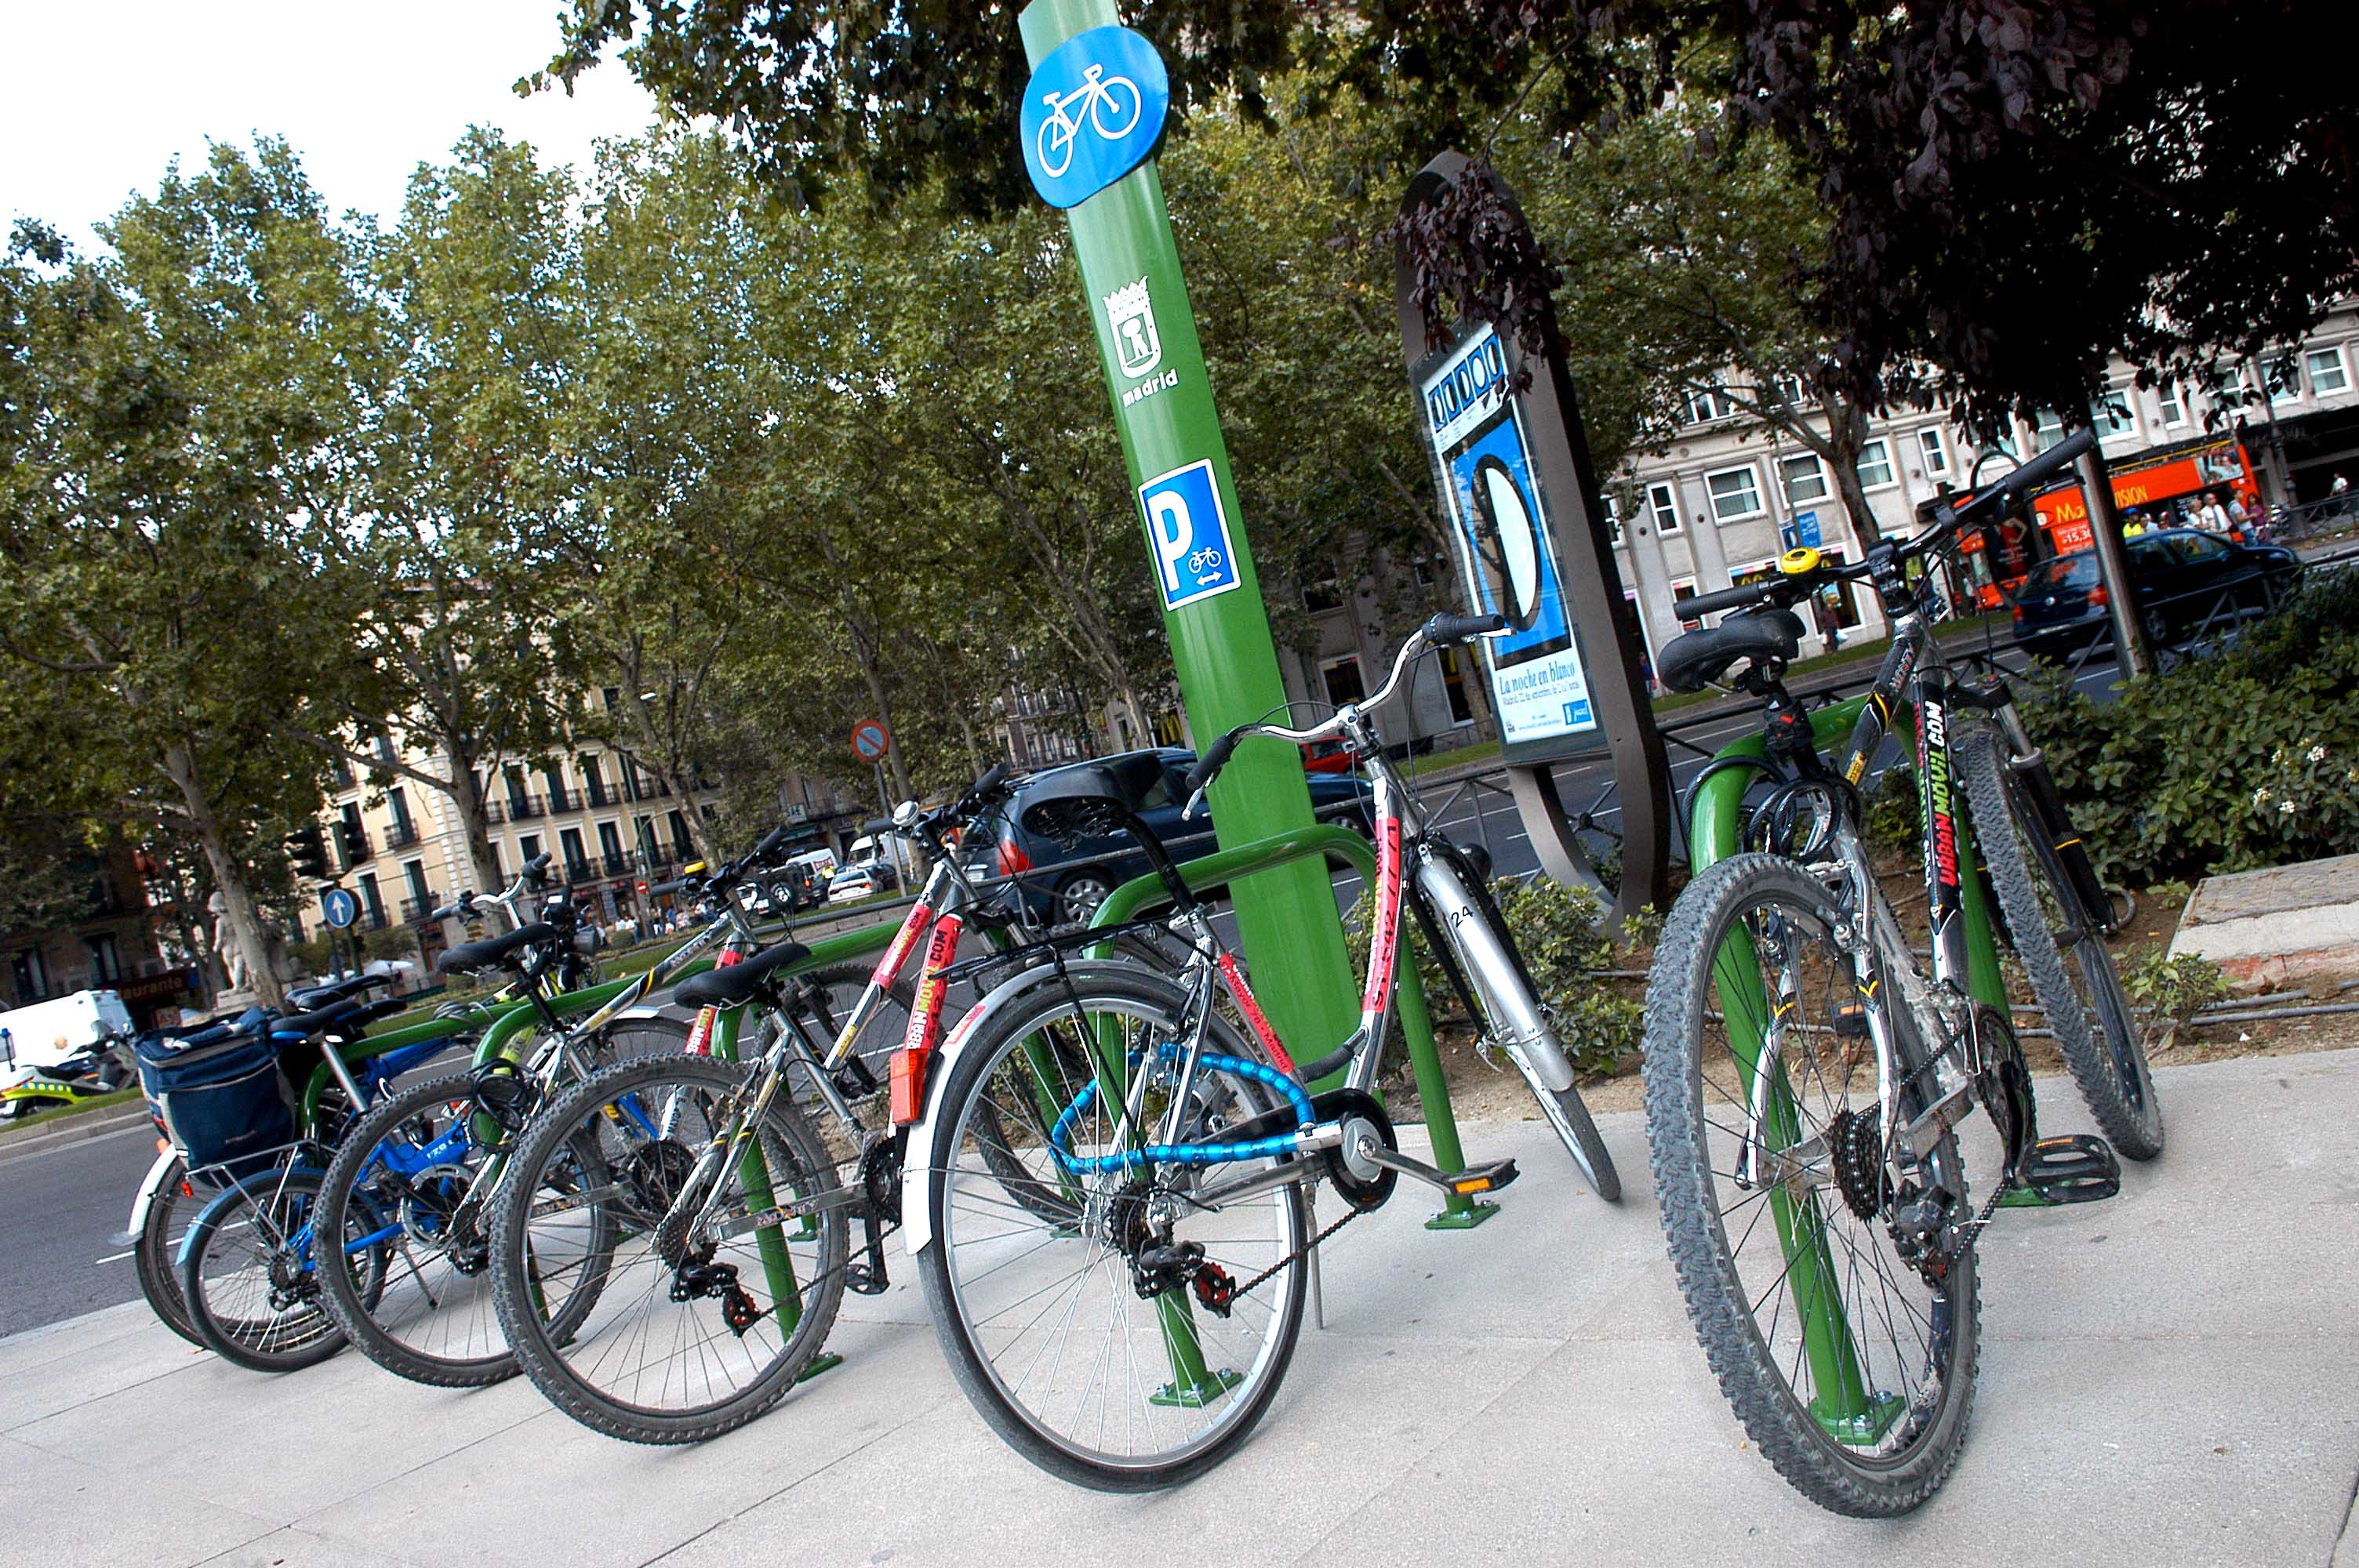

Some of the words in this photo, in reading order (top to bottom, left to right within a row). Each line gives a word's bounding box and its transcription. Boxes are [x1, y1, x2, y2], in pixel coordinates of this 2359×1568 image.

[1122, 368, 1180, 407] madrid
[1147, 489, 1194, 593] P
[1499, 676, 1511, 695] La
[1511, 668, 1537, 691] noche
[1538, 670, 1550, 686] en
[1548, 660, 1576, 682] blanco
[1451, 905, 1474, 928] 24
[1263, 1033, 1289, 1070] Madrid
